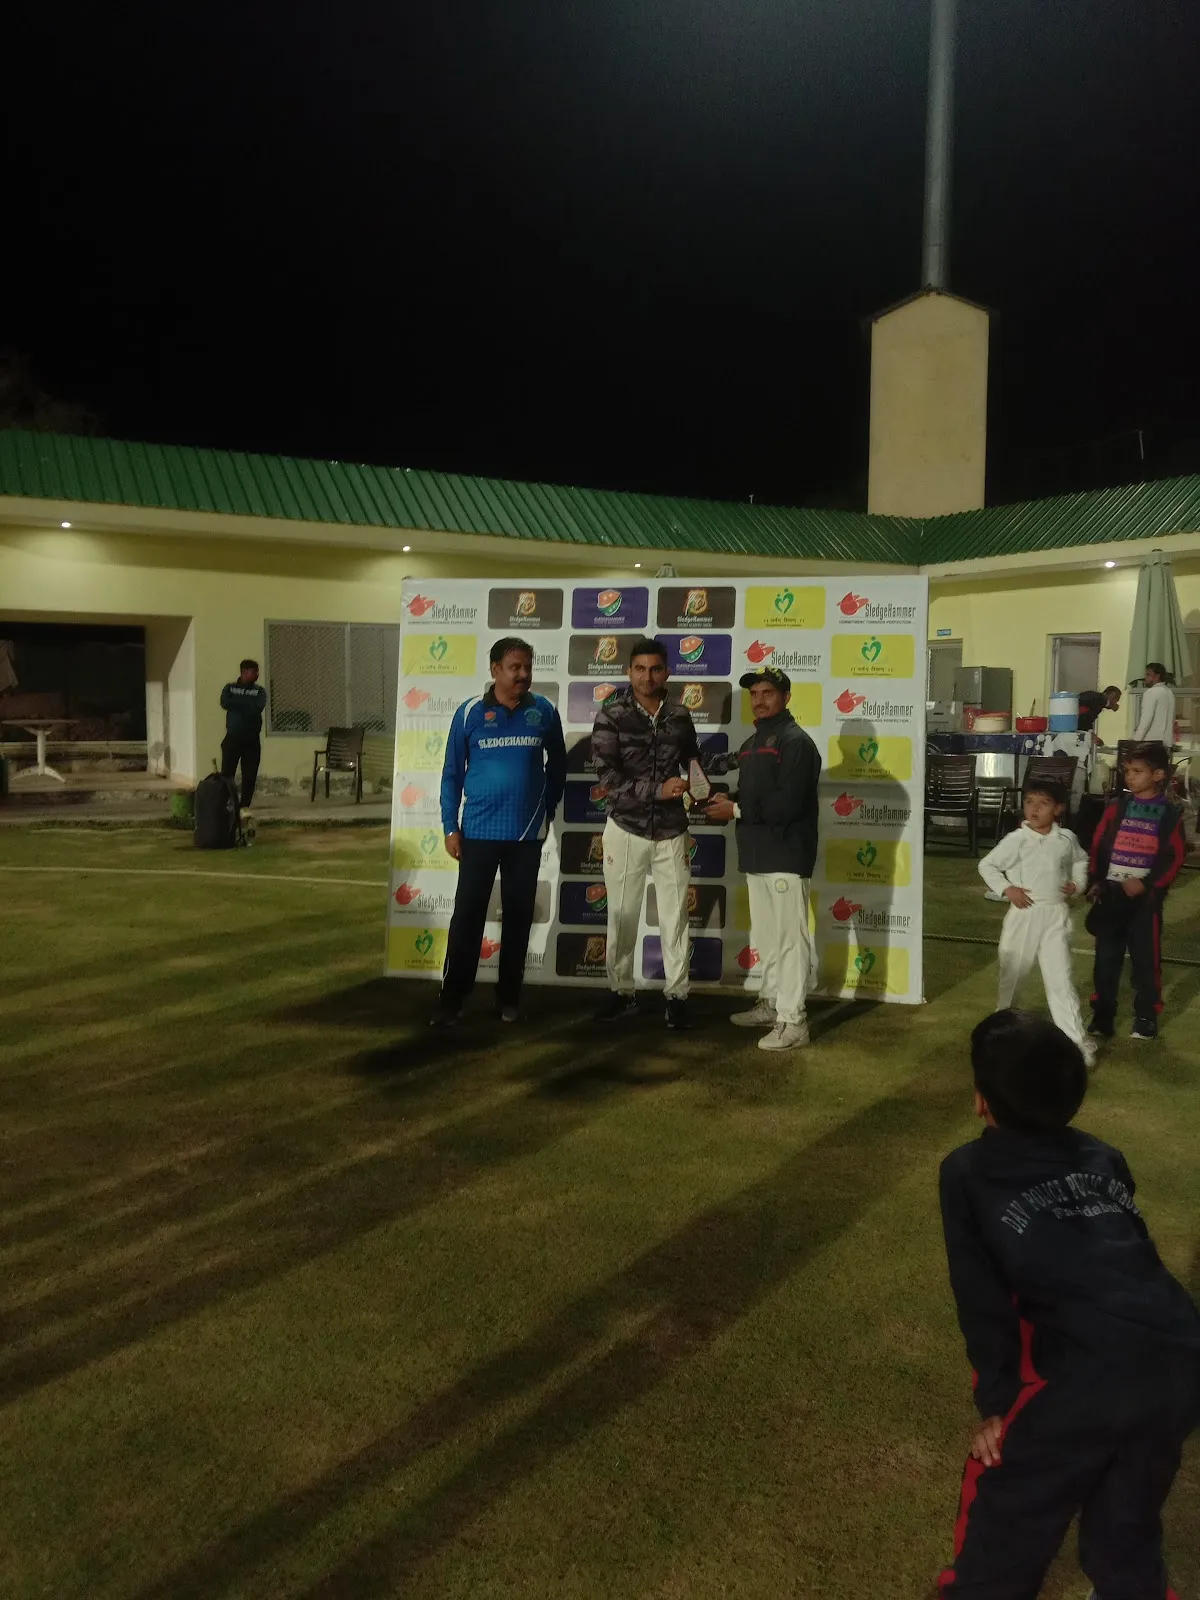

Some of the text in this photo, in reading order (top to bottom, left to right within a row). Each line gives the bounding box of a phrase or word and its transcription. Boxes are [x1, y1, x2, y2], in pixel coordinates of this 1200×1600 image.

[431, 602, 477, 620] SledgeHammer
[865, 603, 916, 620] SledgeHammer
[531, 652, 559, 665] Hammer
[771, 651, 821, 668] SledgeHammer
[862, 700, 914, 718] SledgeHammer
[860, 805, 911, 822] SledgeHammer
[858, 909, 911, 928] SledgeHammer
[1021, 1179, 1069, 1211] POLICE
